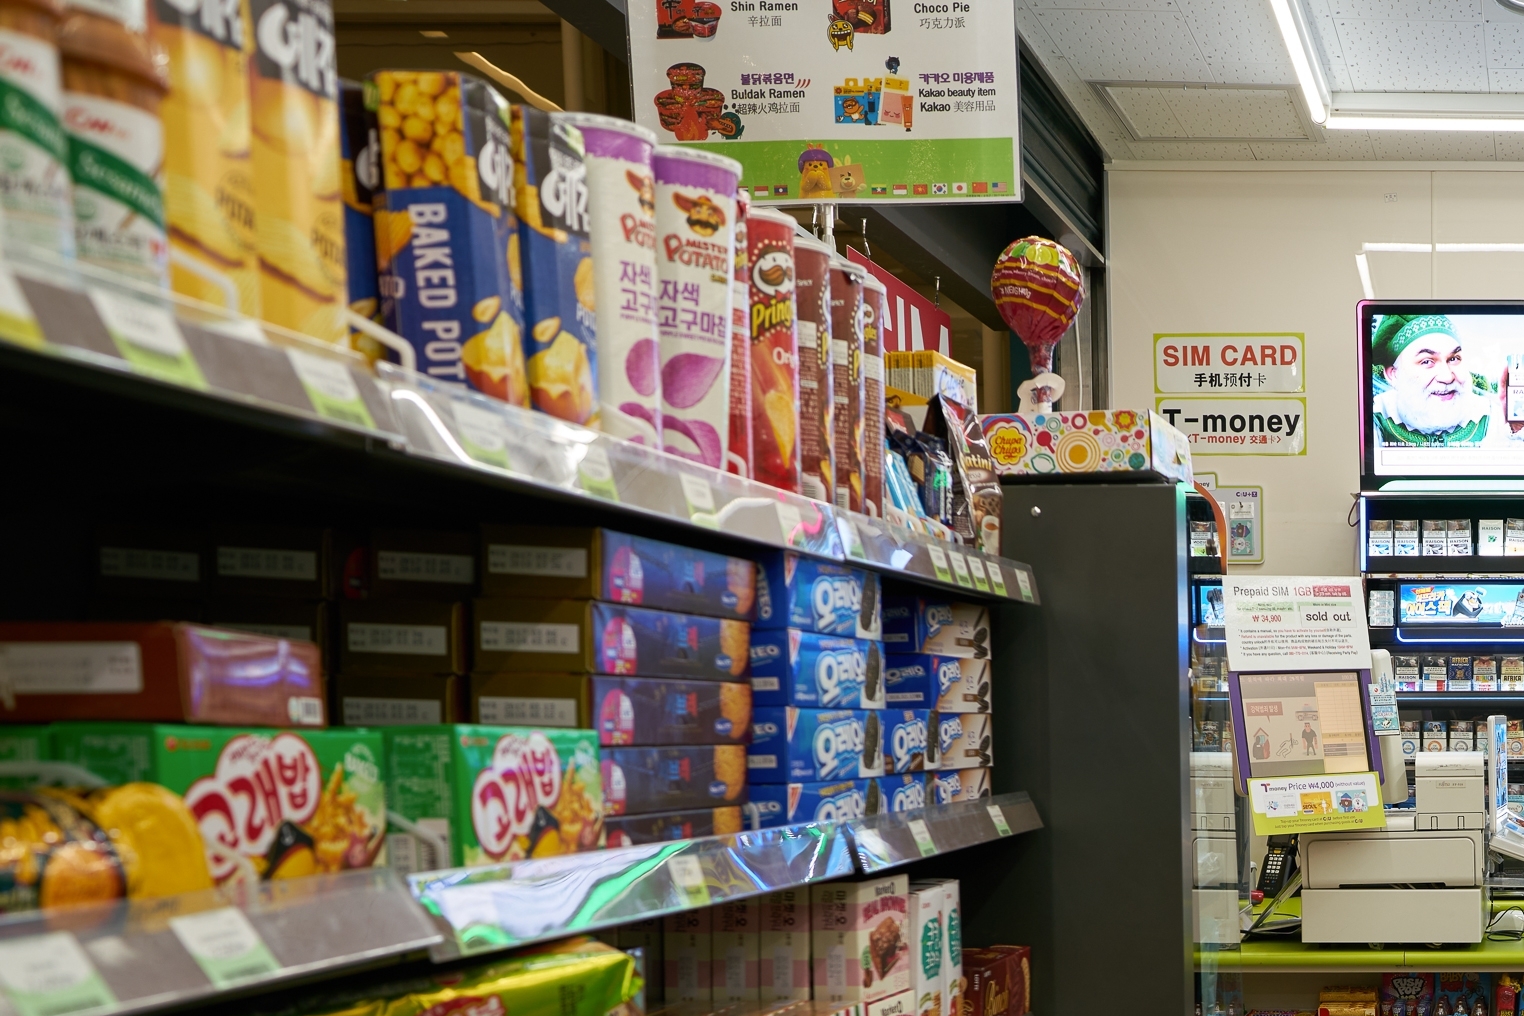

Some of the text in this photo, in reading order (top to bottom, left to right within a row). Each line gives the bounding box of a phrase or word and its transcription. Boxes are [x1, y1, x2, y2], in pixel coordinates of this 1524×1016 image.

[731, 1, 798, 12] Shin Ramen
[914, 3, 970, 14] Choco Pie
[747, 15, 782, 27] 辛拉面
[919, 17, 966, 29] 巧克力派
[740, 73, 795, 85] 불닭볶음면
[918, 72, 995, 84] 카카오 미용제품
[731, 88, 805, 100] Buldak Ramen
[918, 87, 996, 99] Kakao beauty item
[737, 102, 800, 115] 超辣火鸡拉面
[920, 100, 996, 112] Kakao 美容用品
[408, 201, 457, 309] BAKED
[660, 278, 700, 306] 자색
[1163, 345, 1297, 367] SIM CARD
[1193, 373, 1266, 388] 手机预付卡
[1163, 408, 1300, 436] T-money
[995, 436, 1022, 446] Chupa
[993, 444, 1021, 459] Chups
[1234, 587, 1269, 598] Prepaid
[1272, 587, 1289, 596] SIM
[1293, 587, 1311, 596] 1GB
[1261, 614, 1281, 623] 34,900
[1305, 611, 1351, 622] sold out
[751, 645, 780, 660] REO
[1288, 783, 1306, 791] Price
[474, 745, 558, 853] 고래밥
[190, 742, 313, 879] 고래밥
[1396, 977, 1424, 987] PUSH
[1400, 985, 1421, 994] POP
